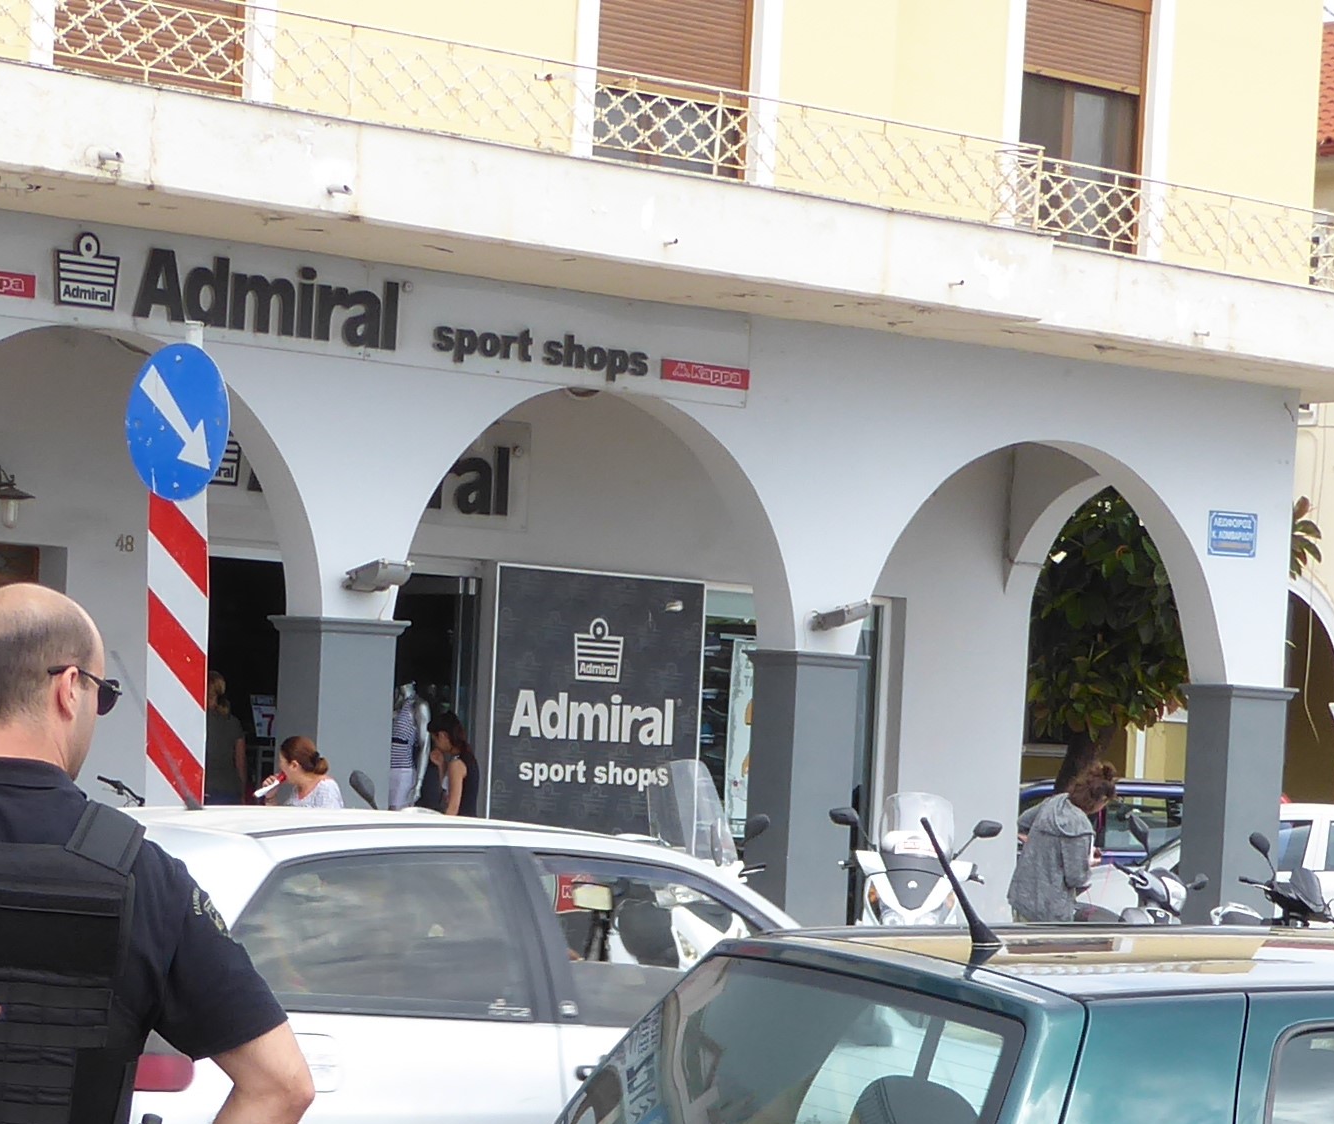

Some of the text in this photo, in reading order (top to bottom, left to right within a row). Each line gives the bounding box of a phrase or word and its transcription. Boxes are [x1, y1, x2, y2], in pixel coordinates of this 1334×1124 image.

[63, 284, 111, 303] Admiral
[132, 247, 648, 382] Admiral sport shops
[691, 364, 742, 385] Kappa
[115, 533, 134, 552] 48
[579, 662, 617, 676] Admiral
[509, 689, 675, 746] Admiral
[519, 760, 669, 792] sport shops
